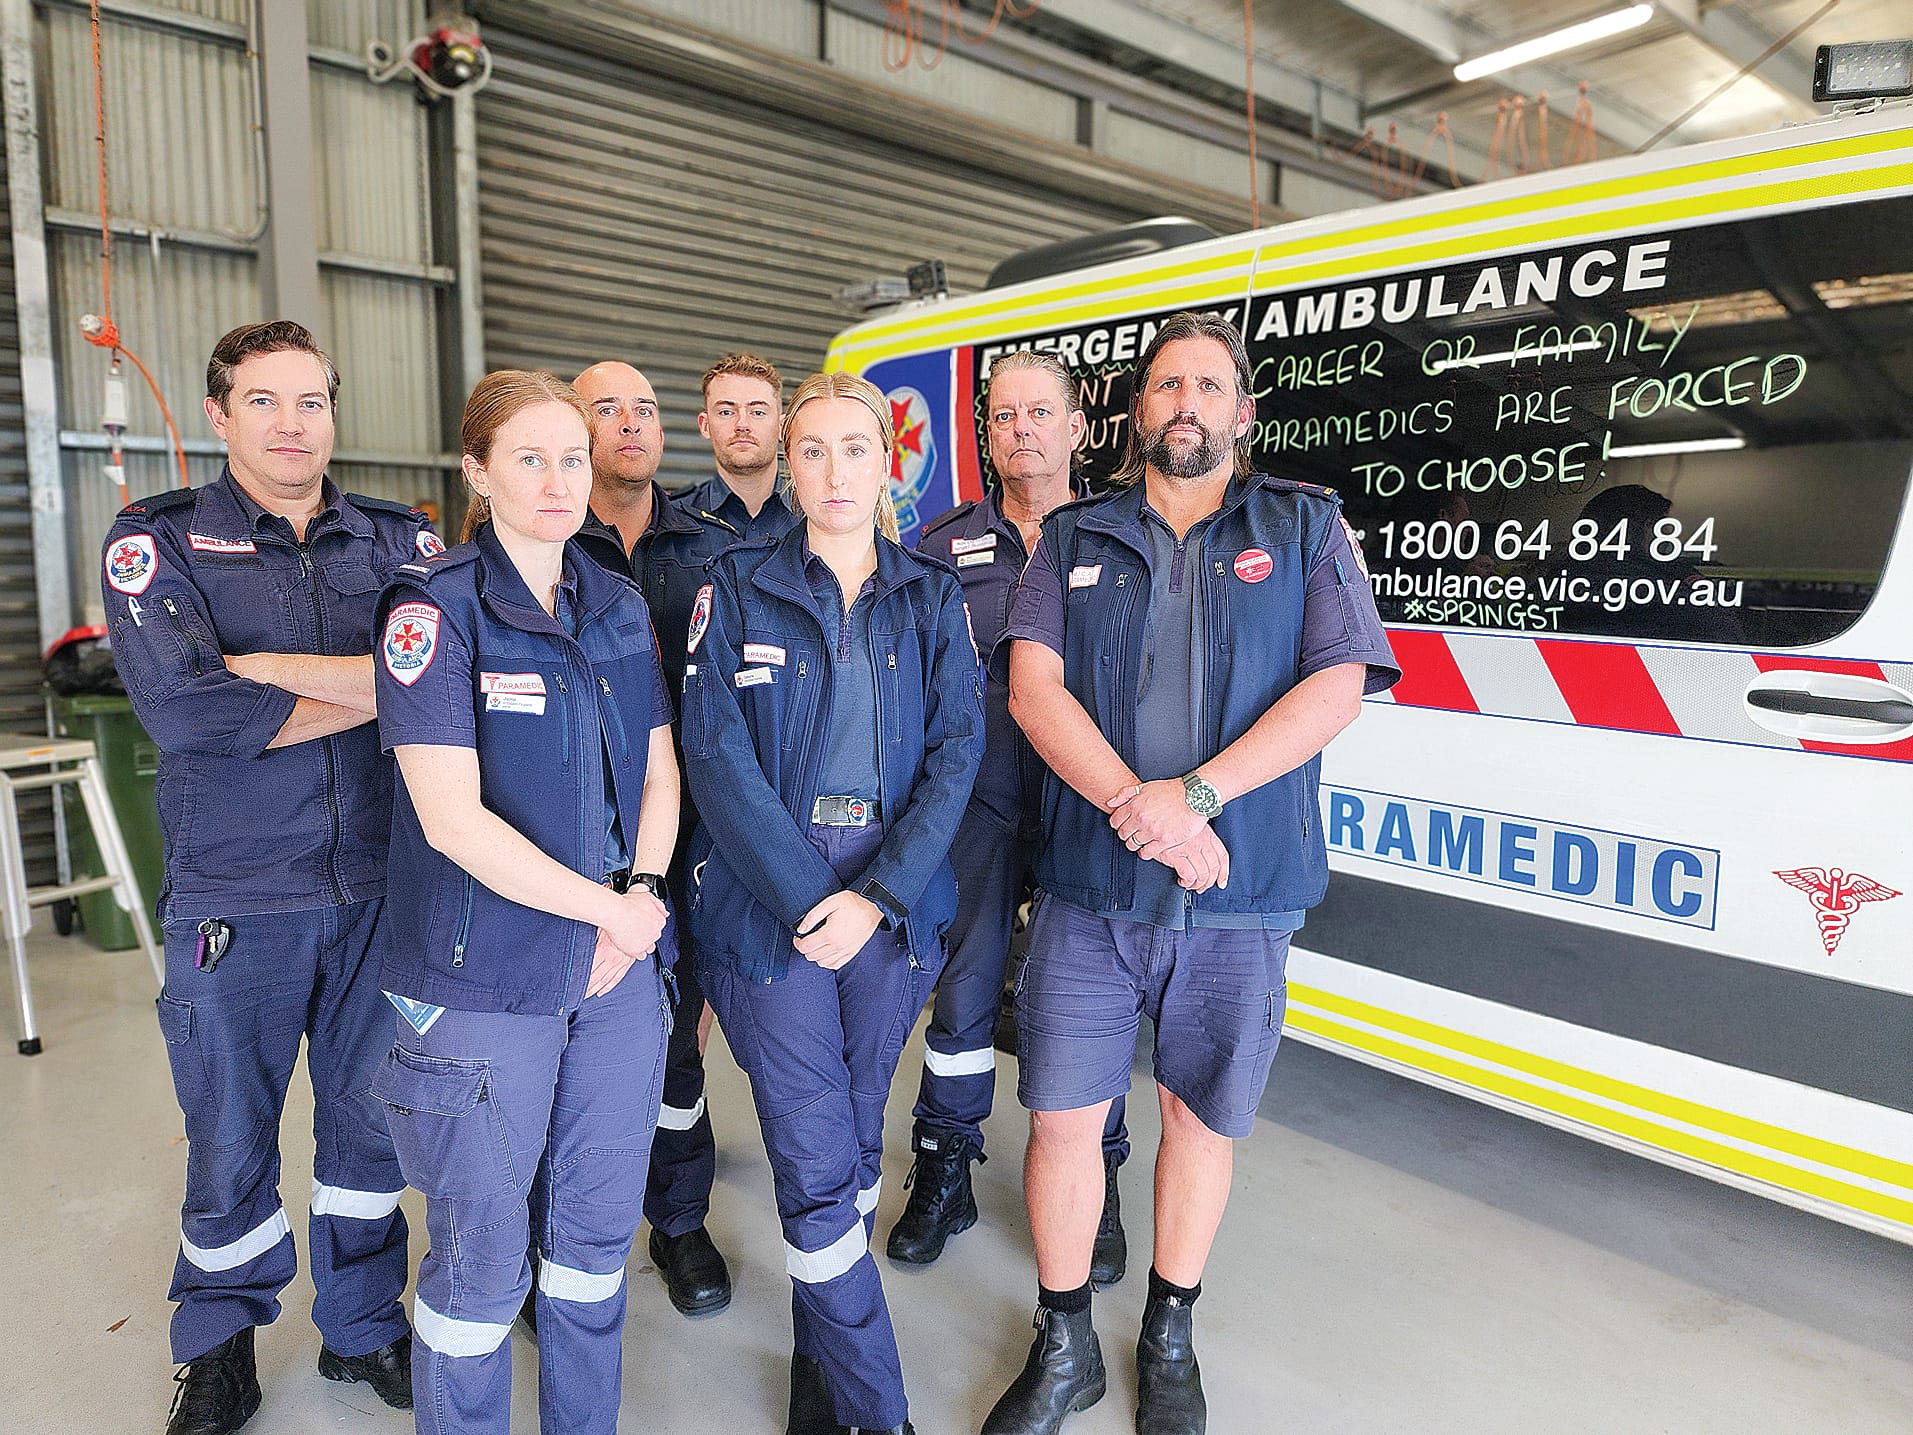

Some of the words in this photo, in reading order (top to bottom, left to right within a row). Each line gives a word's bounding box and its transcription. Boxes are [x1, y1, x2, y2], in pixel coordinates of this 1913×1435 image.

[1254, 240, 1671, 342] AMBULANCE
[1251, 340, 1384, 398] CAREER
[1421, 334, 1477, 376] OR
[1511, 304, 1699, 369] FAMILY
[1251, 400, 1454, 453] PARAMEDICS
[1495, 386, 1572, 432] ARE
[1607, 353, 1807, 422] FORCED
[1351, 460, 1404, 498] TO
[1378, 519, 1480, 561] 1800
[1494, 518, 1552, 561] 64
[1567, 518, 1632, 562] 84
[1648, 517, 1719, 562] 84
[390, 606, 436, 621] PARAMEDIC
[1403, 598, 1565, 631] #SPRINGST
[498, 682, 543, 690] PARAMEDIC
[1329, 791, 1704, 918] RAMEDIC
